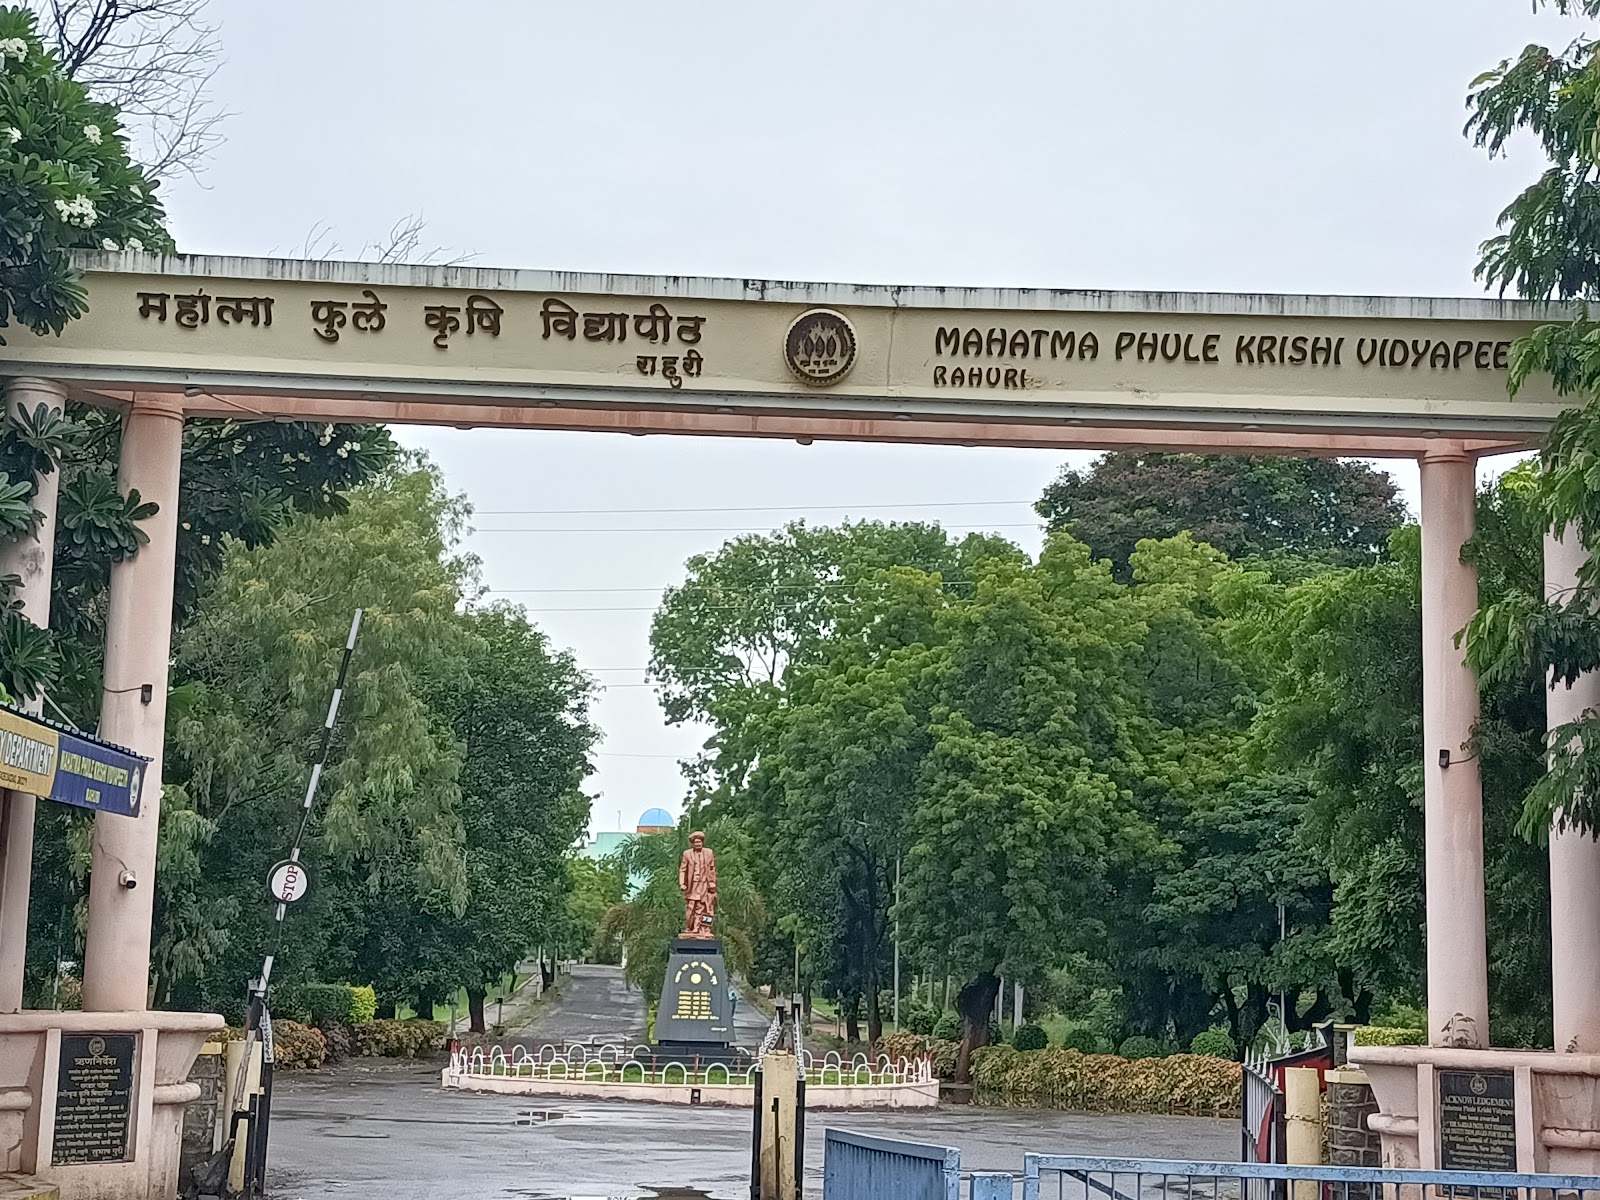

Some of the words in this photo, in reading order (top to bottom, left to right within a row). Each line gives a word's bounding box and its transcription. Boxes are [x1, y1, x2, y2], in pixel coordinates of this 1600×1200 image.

[136, 288, 275, 329] महात्मा
[310, 290, 388, 343] फुले
[424, 295, 504, 349] कृषि
[539, 298, 706, 344] विद्यापीठ
[935, 326, 1099, 360] MAHATMA
[1115, 331, 1221, 362] PHULE
[1235, 335, 1345, 366] KRISHI
[1356, 337, 1512, 369] VIDYAPEE
[636, 348, 704, 389] राहुरी
[933, 365, 1028, 389] RAHURI
[4, 731, 54, 776] DEPARTMENT
[282, 866, 298, 901] STOP
[1445, 1095, 1514, 1107] ACKNOWLEDGEMENT
